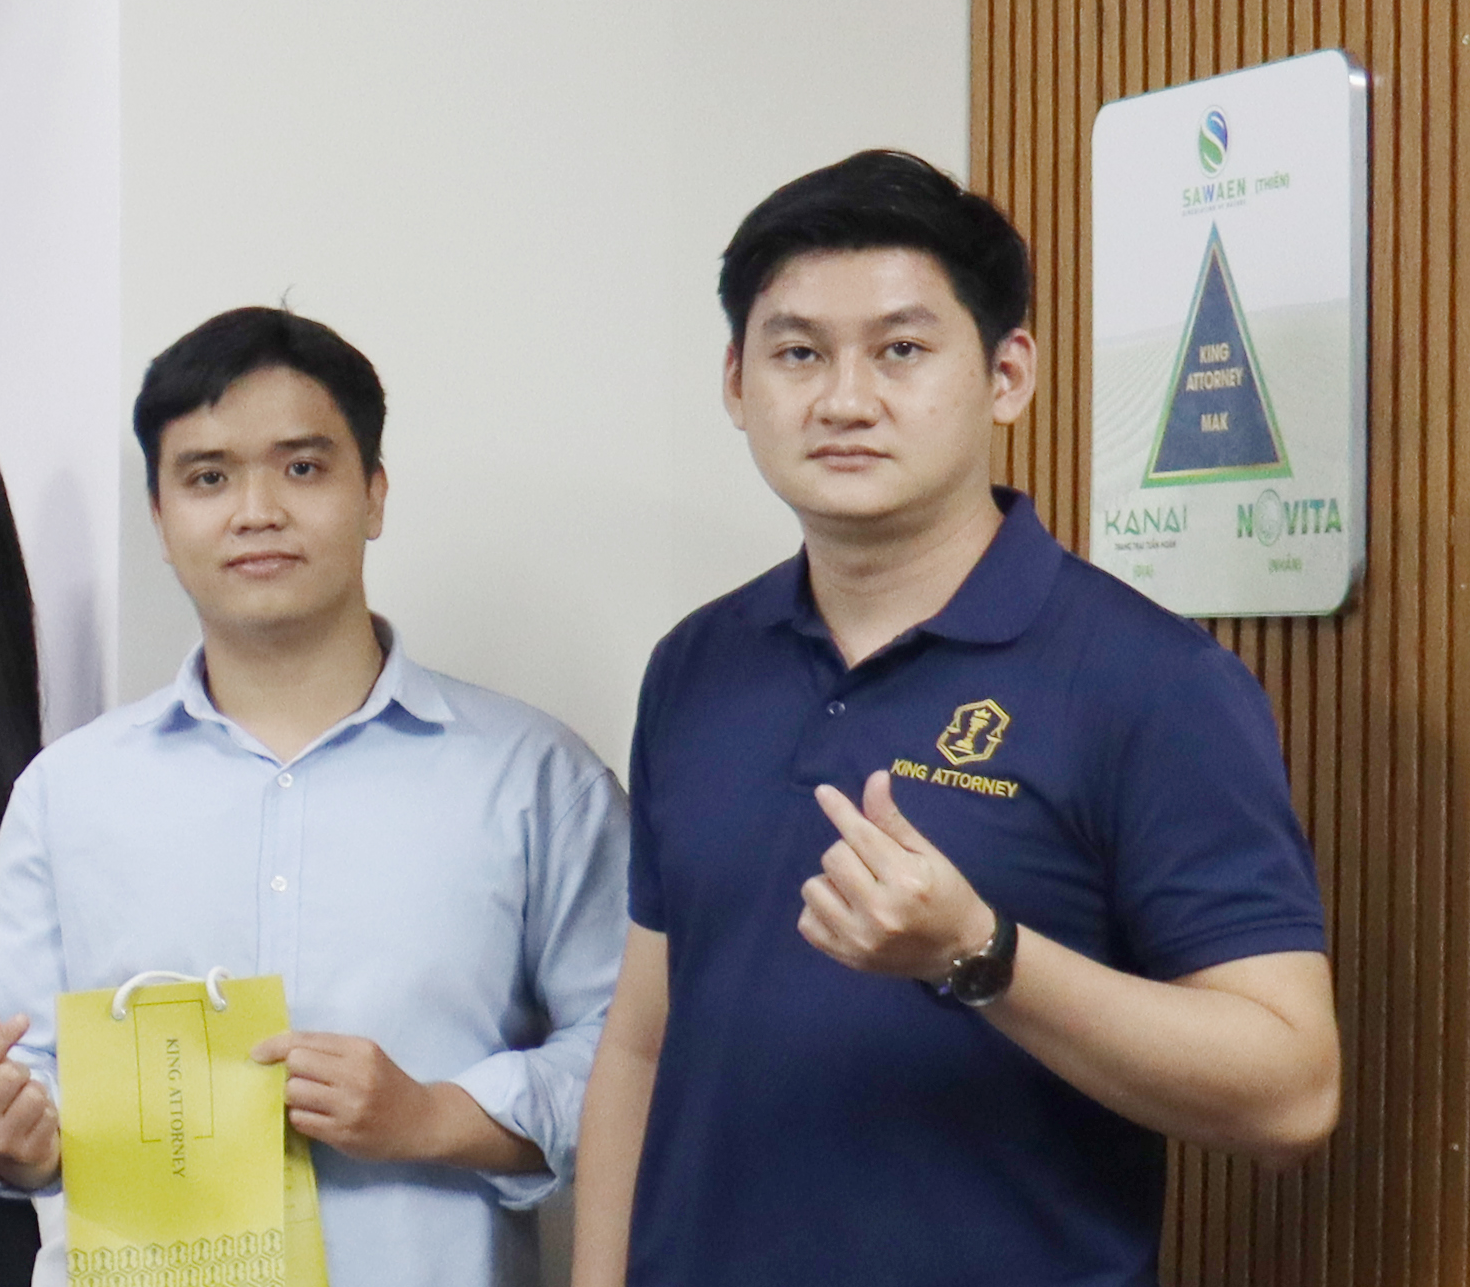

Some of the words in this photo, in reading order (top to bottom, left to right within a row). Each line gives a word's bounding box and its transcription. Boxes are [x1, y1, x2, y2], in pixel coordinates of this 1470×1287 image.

[1182, 178, 1247, 208] SAWAEN
[1198, 342, 1231, 365] KING
[1185, 366, 1245, 392] ATTORNEY
[1200, 411, 1229, 433] MAK
[1104, 504, 1188, 536] KANAI
[890, 758, 929, 781] KING
[930, 766, 1019, 798] ATTORNEY
[165, 1038, 183, 1081] KING
[167, 1086, 187, 1180] ATTORNEY
